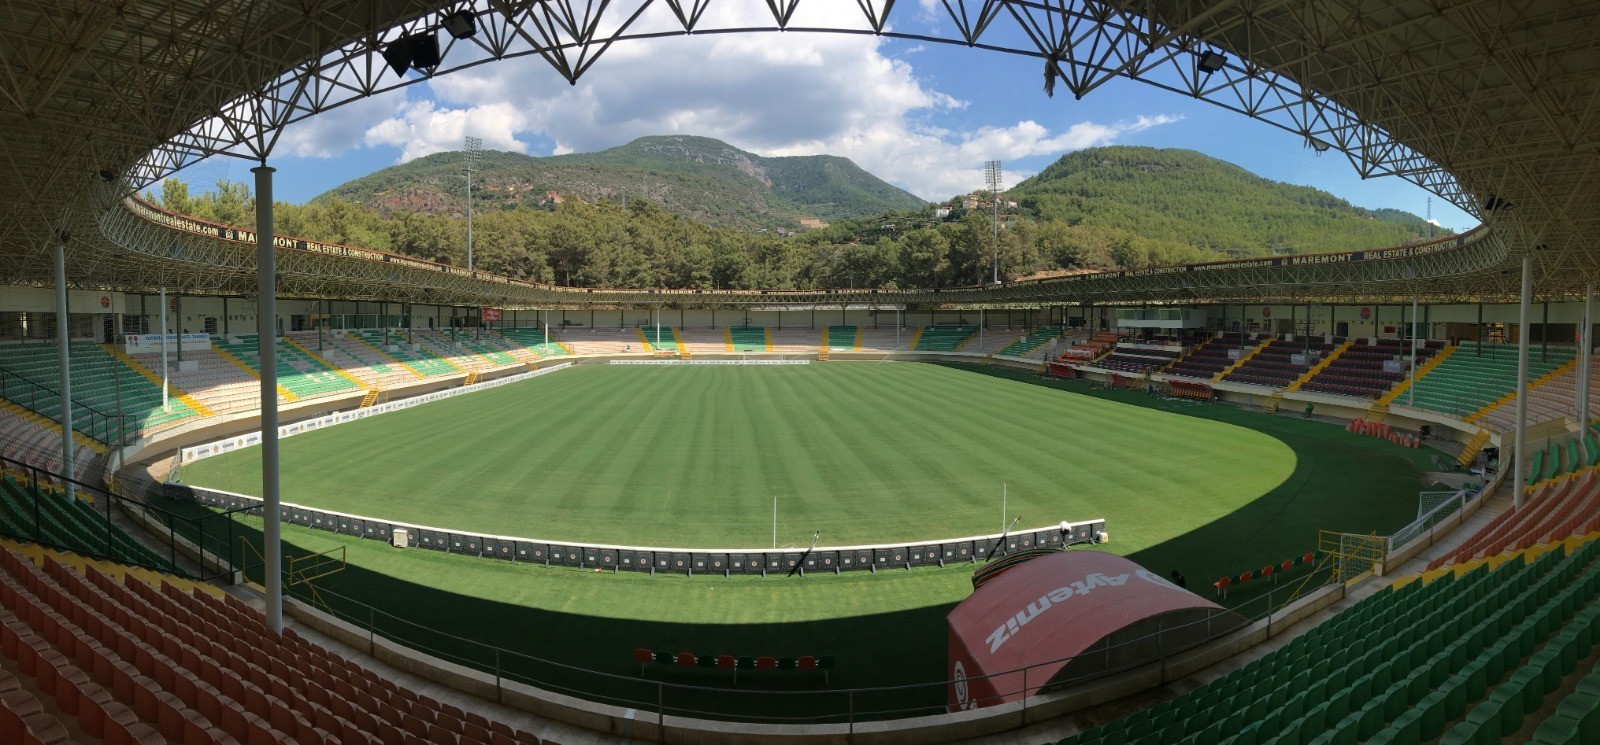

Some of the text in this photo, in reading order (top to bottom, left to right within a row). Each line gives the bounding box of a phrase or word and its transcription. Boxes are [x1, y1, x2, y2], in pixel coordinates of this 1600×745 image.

[238, 230, 298, 249] MAONT
[306, 241, 321, 252] REAL
[323, 244, 342, 256] ESTATE
[348, 247, 384, 261] CONSTRUCTION
[1293, 253, 1353, 265] MAREMONT
[1363, 251, 1381, 261] REAL
[1383, 248, 1407, 259] ESTATE
[1414, 239, 1458, 255] CONSTRUCTION
[1090, 271, 1120, 279] MAREMONT
[985, 572, 1130, 654] Aytemiz
